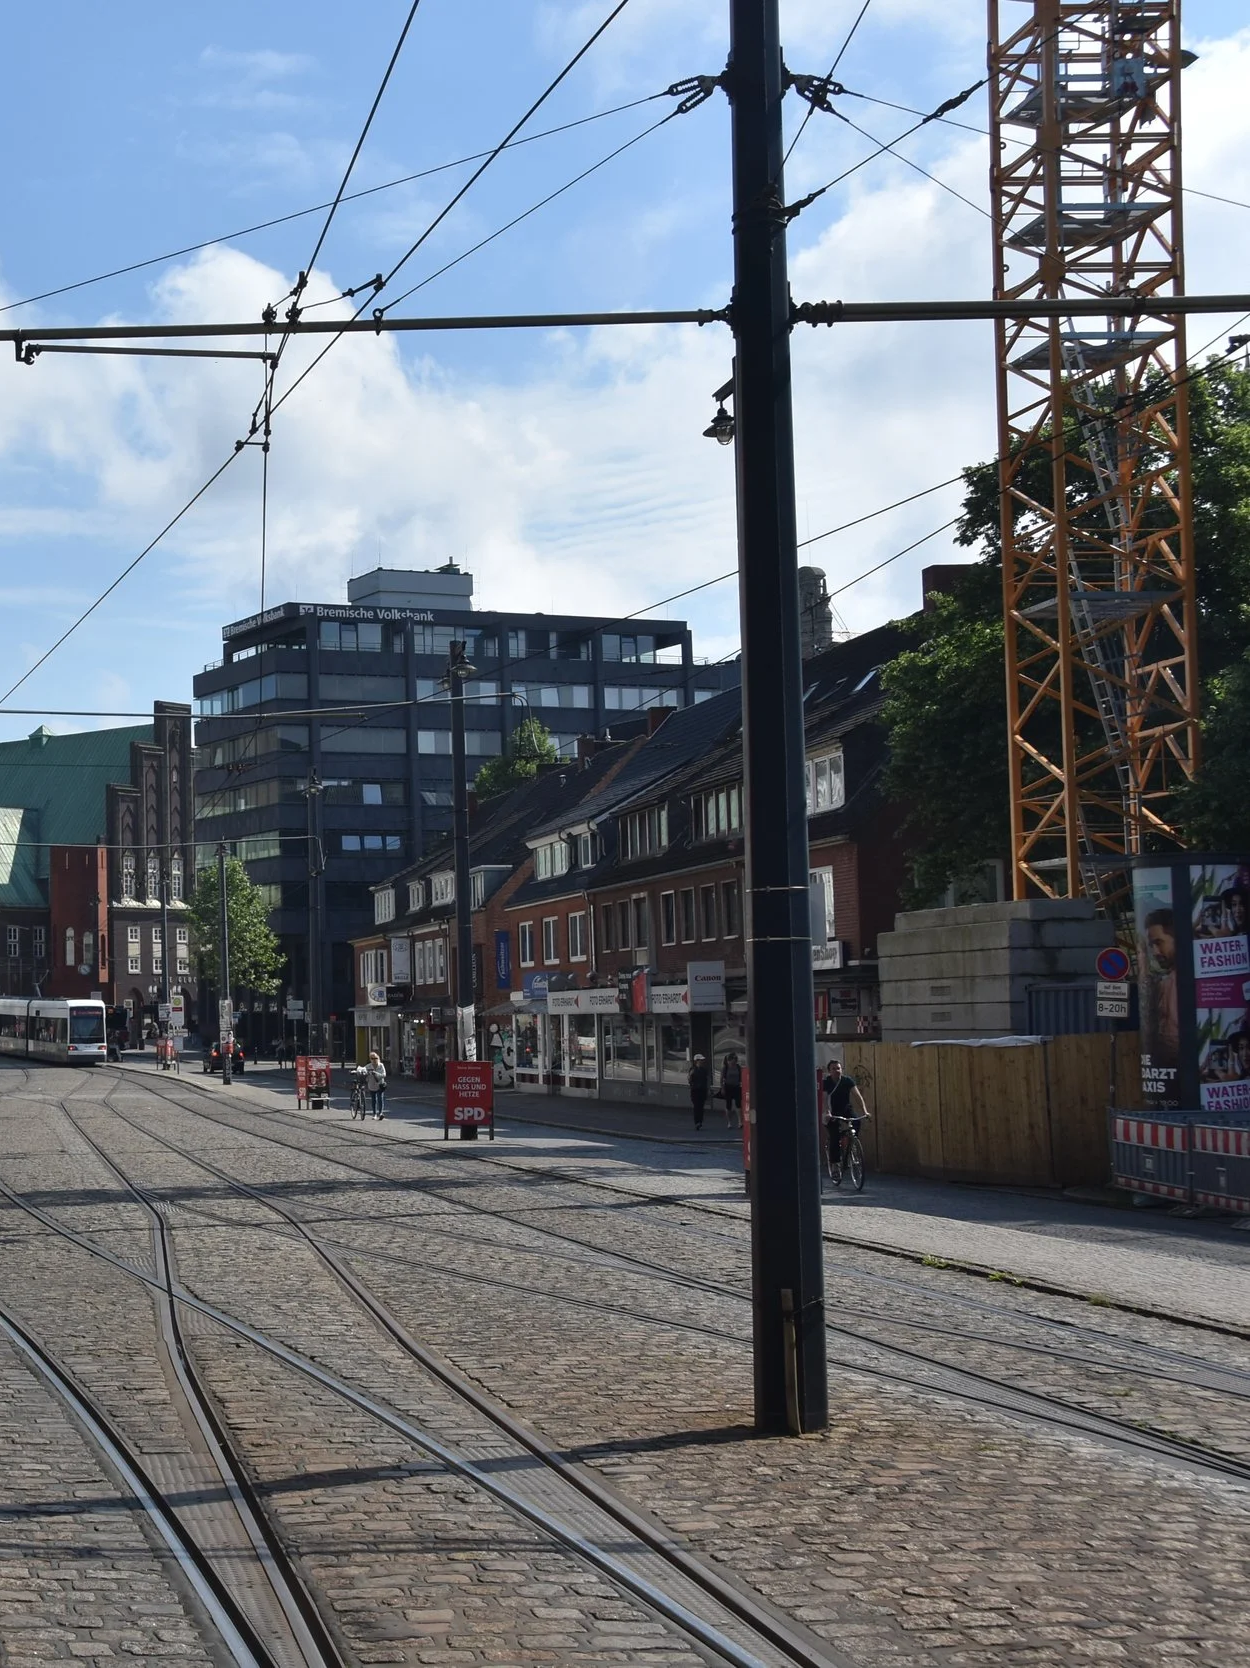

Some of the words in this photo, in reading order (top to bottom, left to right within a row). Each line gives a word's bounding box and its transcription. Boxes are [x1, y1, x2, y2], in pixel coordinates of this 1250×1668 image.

[231, 617, 256, 635] Bremische
[257, 607, 285, 626] Vlksbank
[316, 606, 374, 619] Bremische
[376, 608, 434, 622] Volksbank
[1200, 940, 1244, 954] WATER-
[1200, 952, 1248, 968] FASHION
[694, 974, 722, 982] Canon
[1142, 1081, 1166, 1093] AXIS
[1206, 1097, 1250, 1112] FASHIO
[453, 1106, 486, 1121] SPD
